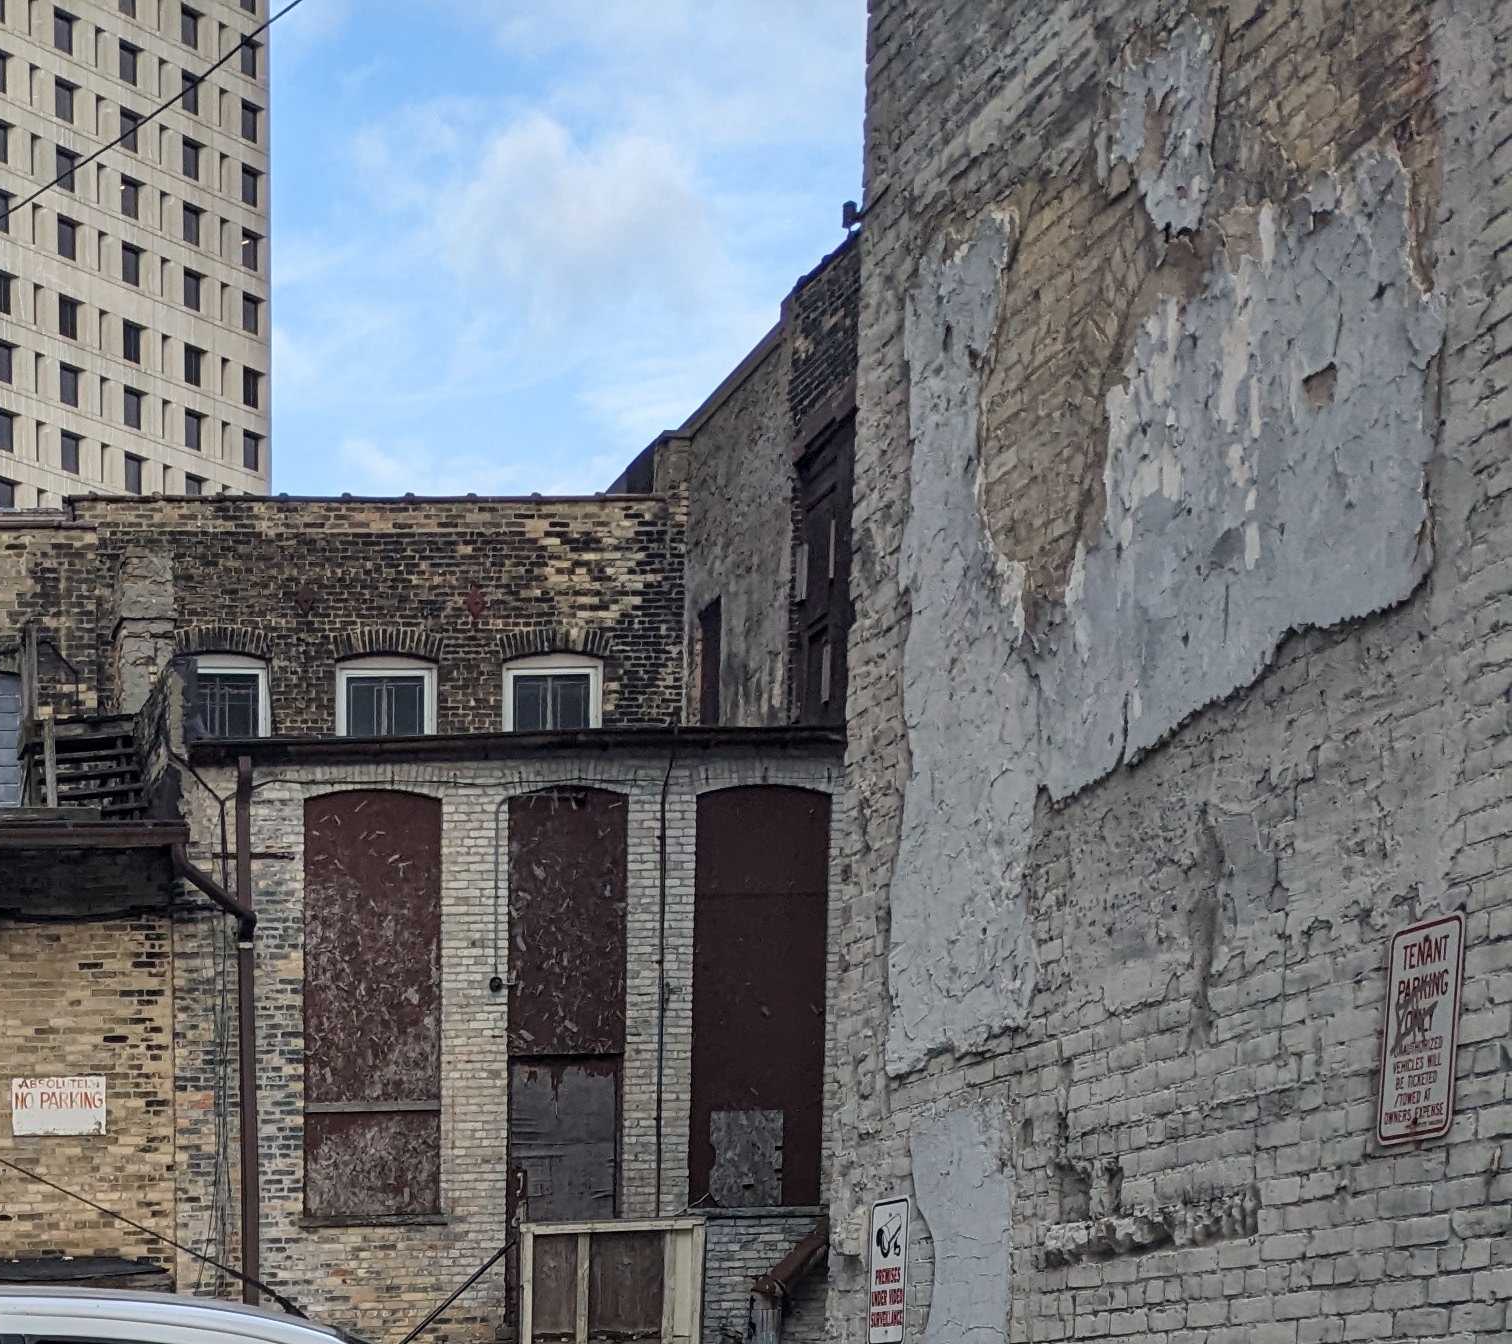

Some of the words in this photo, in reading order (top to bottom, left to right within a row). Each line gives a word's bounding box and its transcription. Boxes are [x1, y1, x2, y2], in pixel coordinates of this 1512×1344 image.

[1403, 934, 1449, 971] TENANT
[1398, 969, 1449, 1004] PARKING
[1393, 1056, 1424, 1074] VEHICLES
[1427, 1054, 1442, 1068] WILL
[18, 1078, 100, 1089] ABSOLUTELY
[1395, 1077, 1405, 1090] BE
[1408, 1071, 1438, 1088] TICKETED
[14, 1092, 34, 1110] NO
[40, 1091, 103, 1110] PARKING
[1424, 1088, 1431, 1102] AT
[1384, 1108, 1411, 1125] OWNERS
[1415, 1102, 1444, 1120] EXPENSE
[875, 1266, 901, 1286] PREMISES
[872, 1290, 887, 1307] UNDER
[889, 1288, 903, 1305] VIDEO
[871, 1310, 903, 1328] SURVEILLANCE
